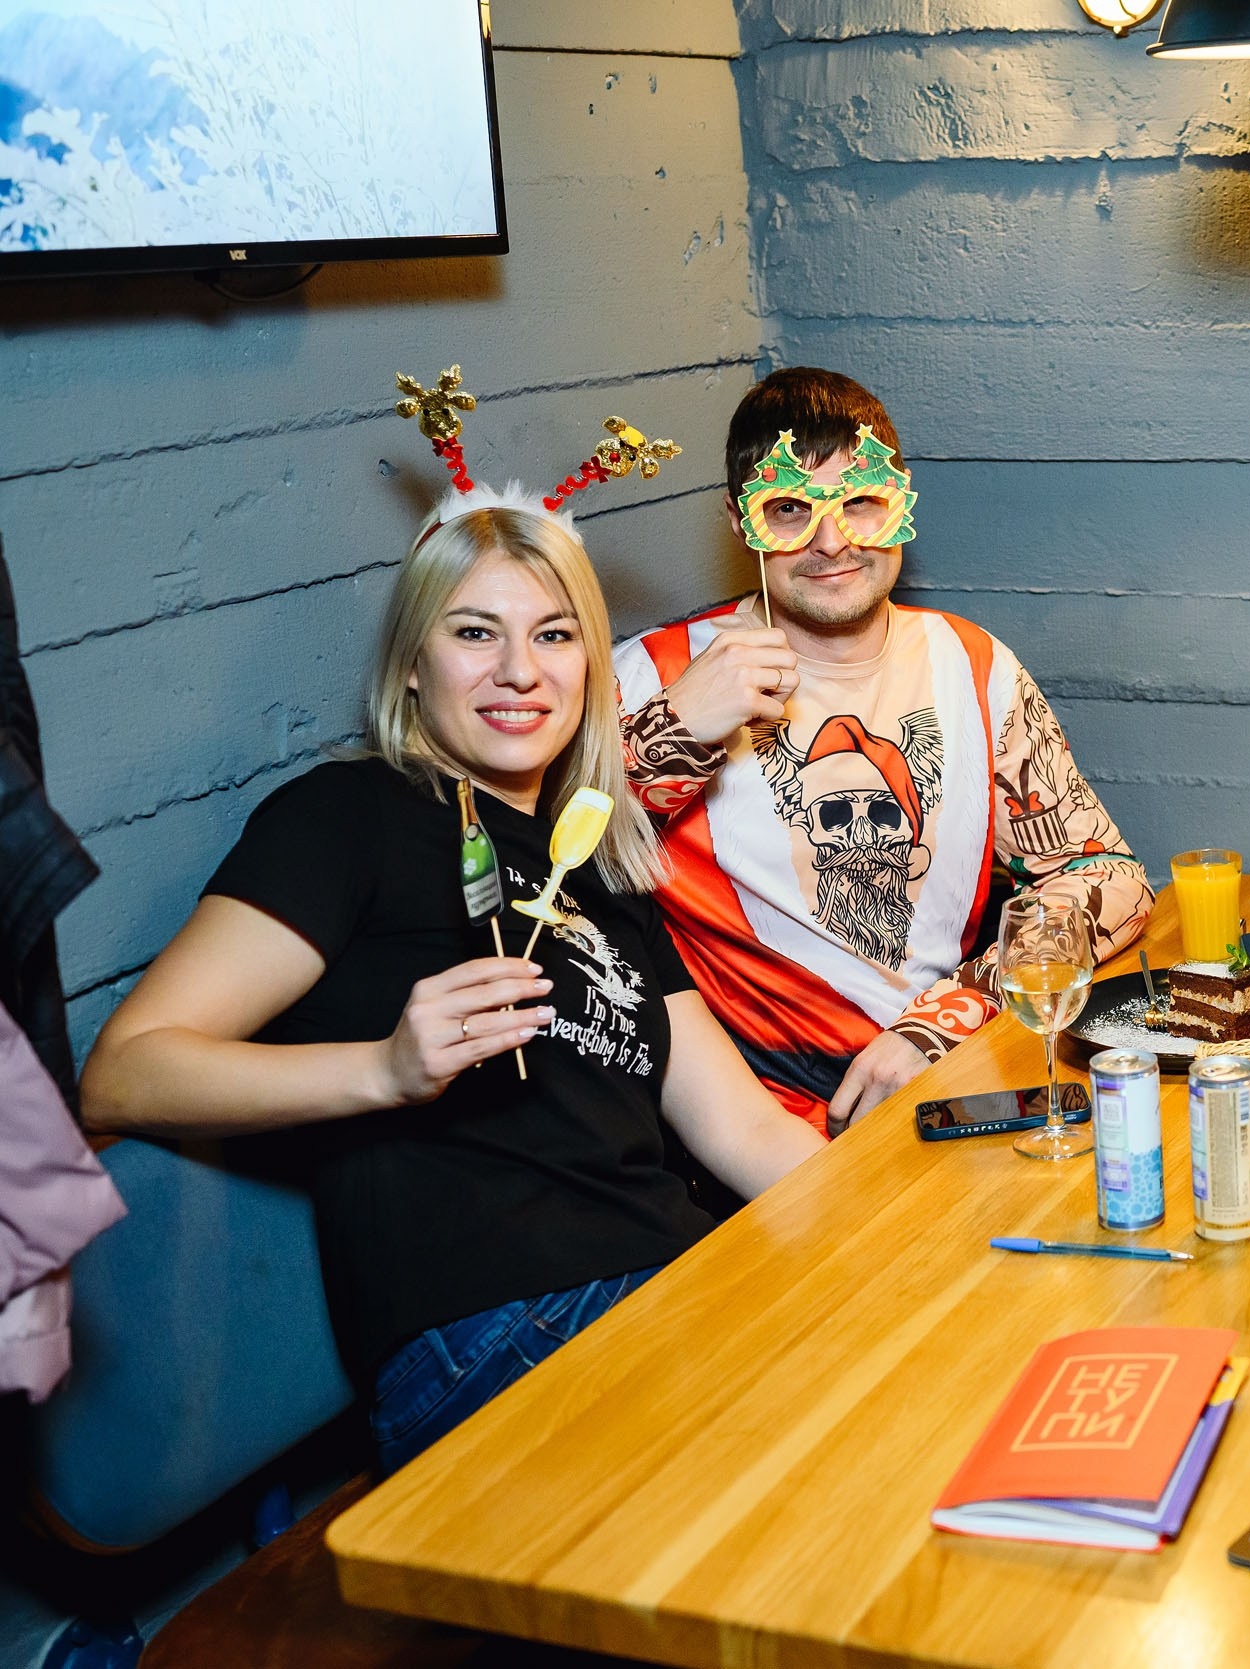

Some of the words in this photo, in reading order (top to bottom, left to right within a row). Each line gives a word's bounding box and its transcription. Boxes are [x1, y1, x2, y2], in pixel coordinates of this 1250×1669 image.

[584, 985, 607, 1021] I'm
[616, 1035, 631, 1066] Is
[627, 1042, 653, 1076] Fine
[1071, 1362, 1149, 1389] НЕ
[1066, 1387, 1138, 1414] ТУ
